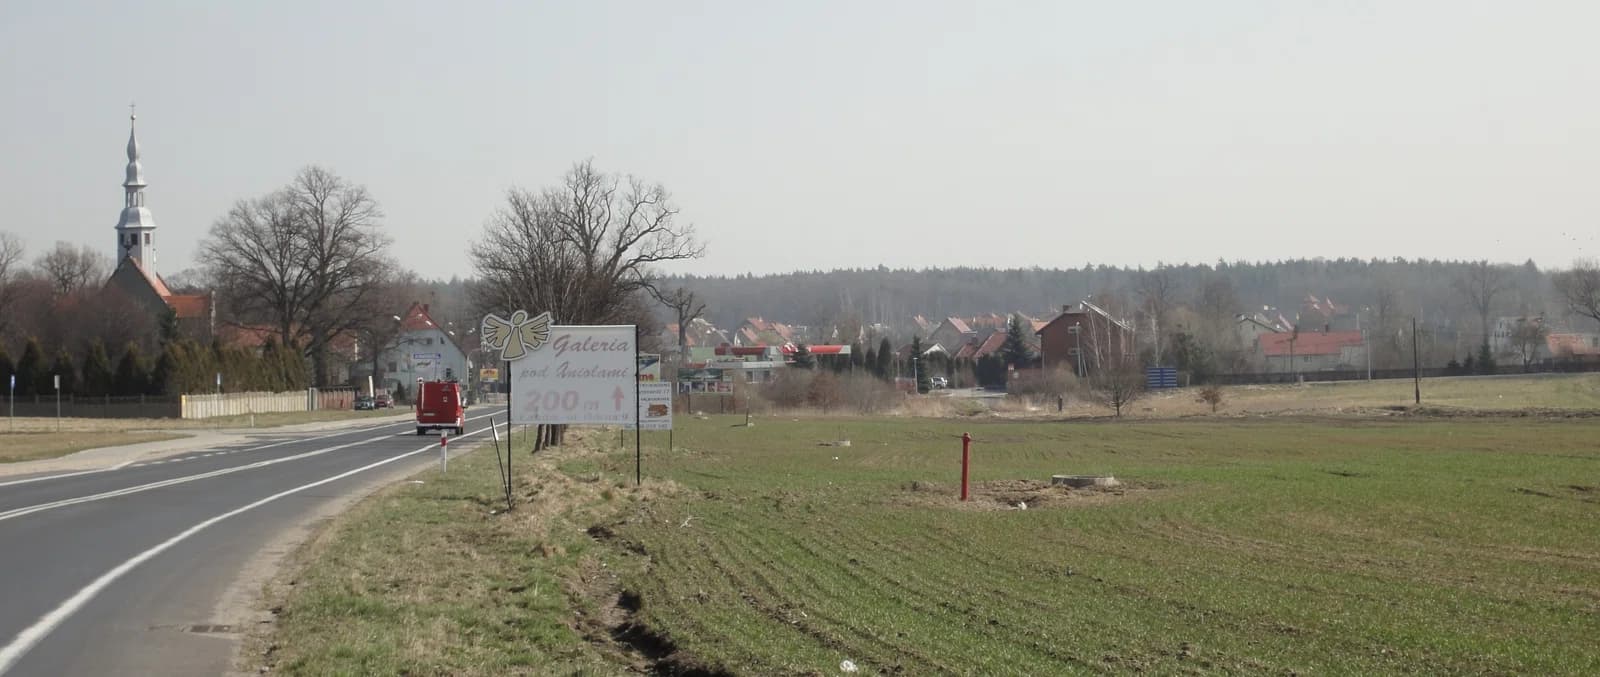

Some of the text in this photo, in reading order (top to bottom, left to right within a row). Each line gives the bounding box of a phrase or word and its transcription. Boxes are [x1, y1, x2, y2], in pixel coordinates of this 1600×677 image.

[552, 333, 630, 357] Galeria
[519, 364, 549, 382] pod
[524, 389, 599, 412] 200 m
